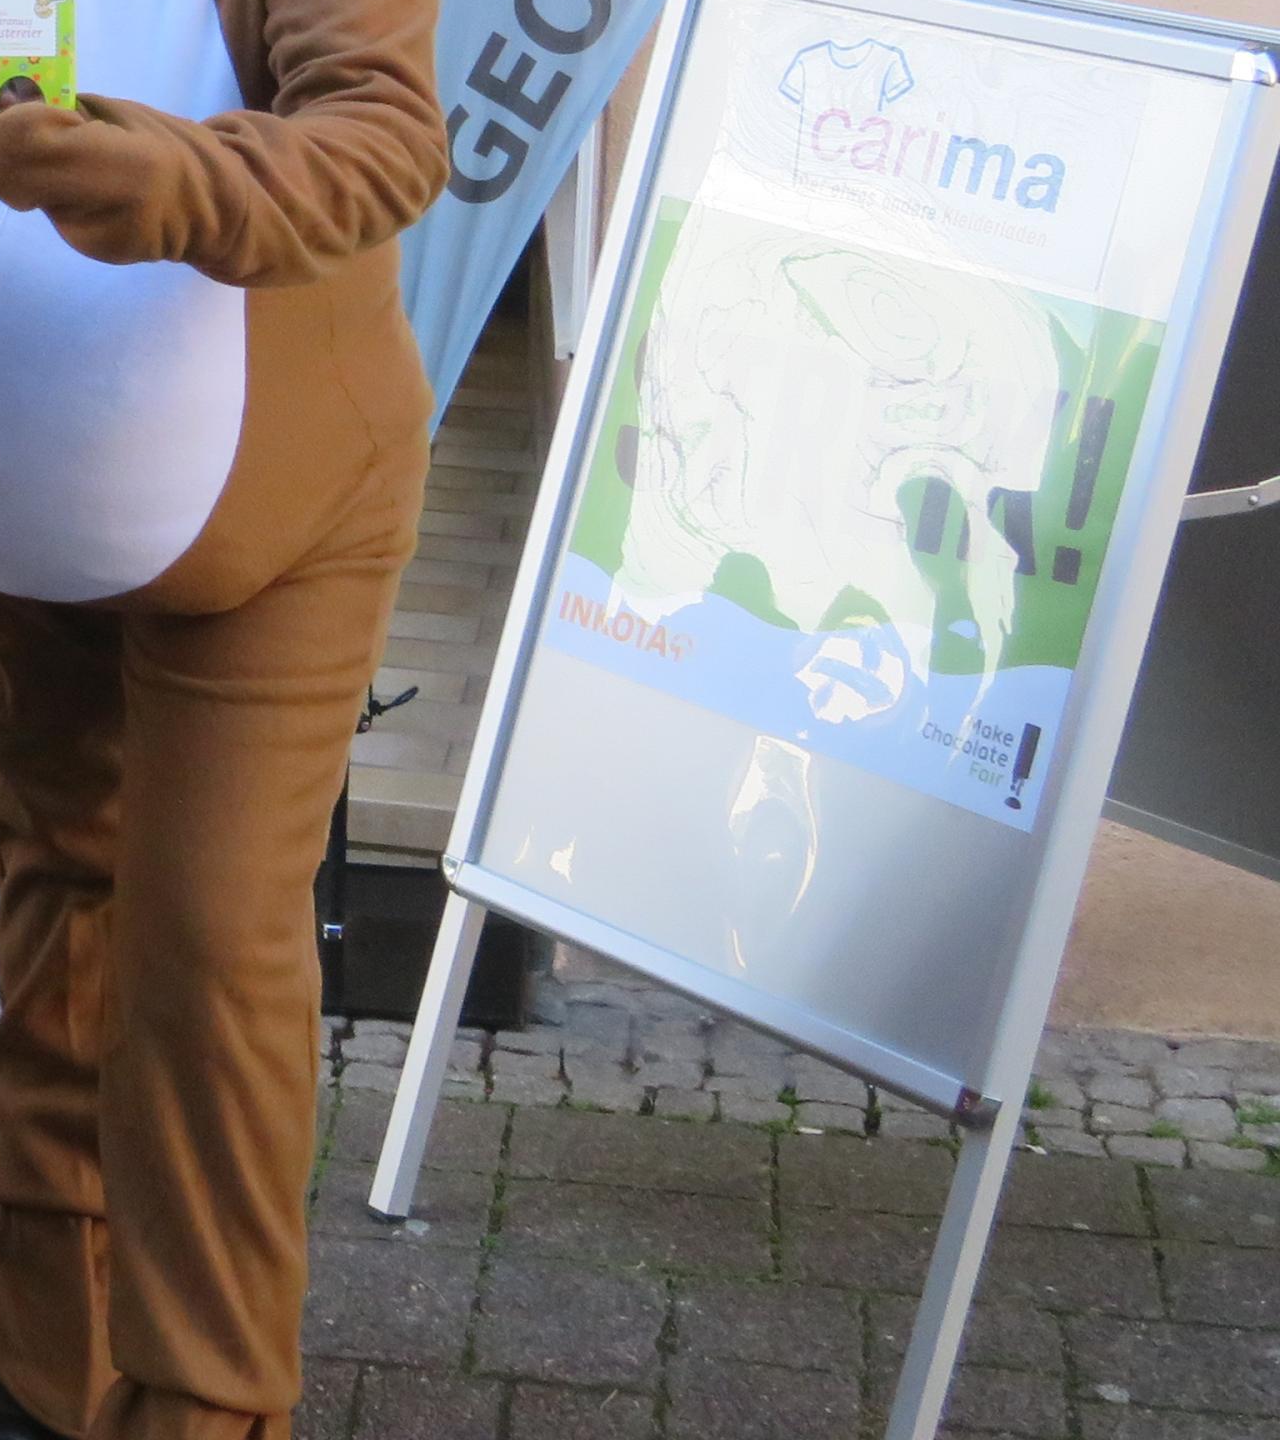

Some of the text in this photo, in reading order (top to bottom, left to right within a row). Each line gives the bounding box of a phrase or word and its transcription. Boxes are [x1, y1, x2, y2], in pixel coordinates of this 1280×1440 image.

[811, 107, 1066, 214] carima
[560, 591, 667, 658] INKOTA
[922, 721, 1009, 768] Chocolate
[971, 718, 1014, 748] Make
[969, 760, 1006, 788] Fair
